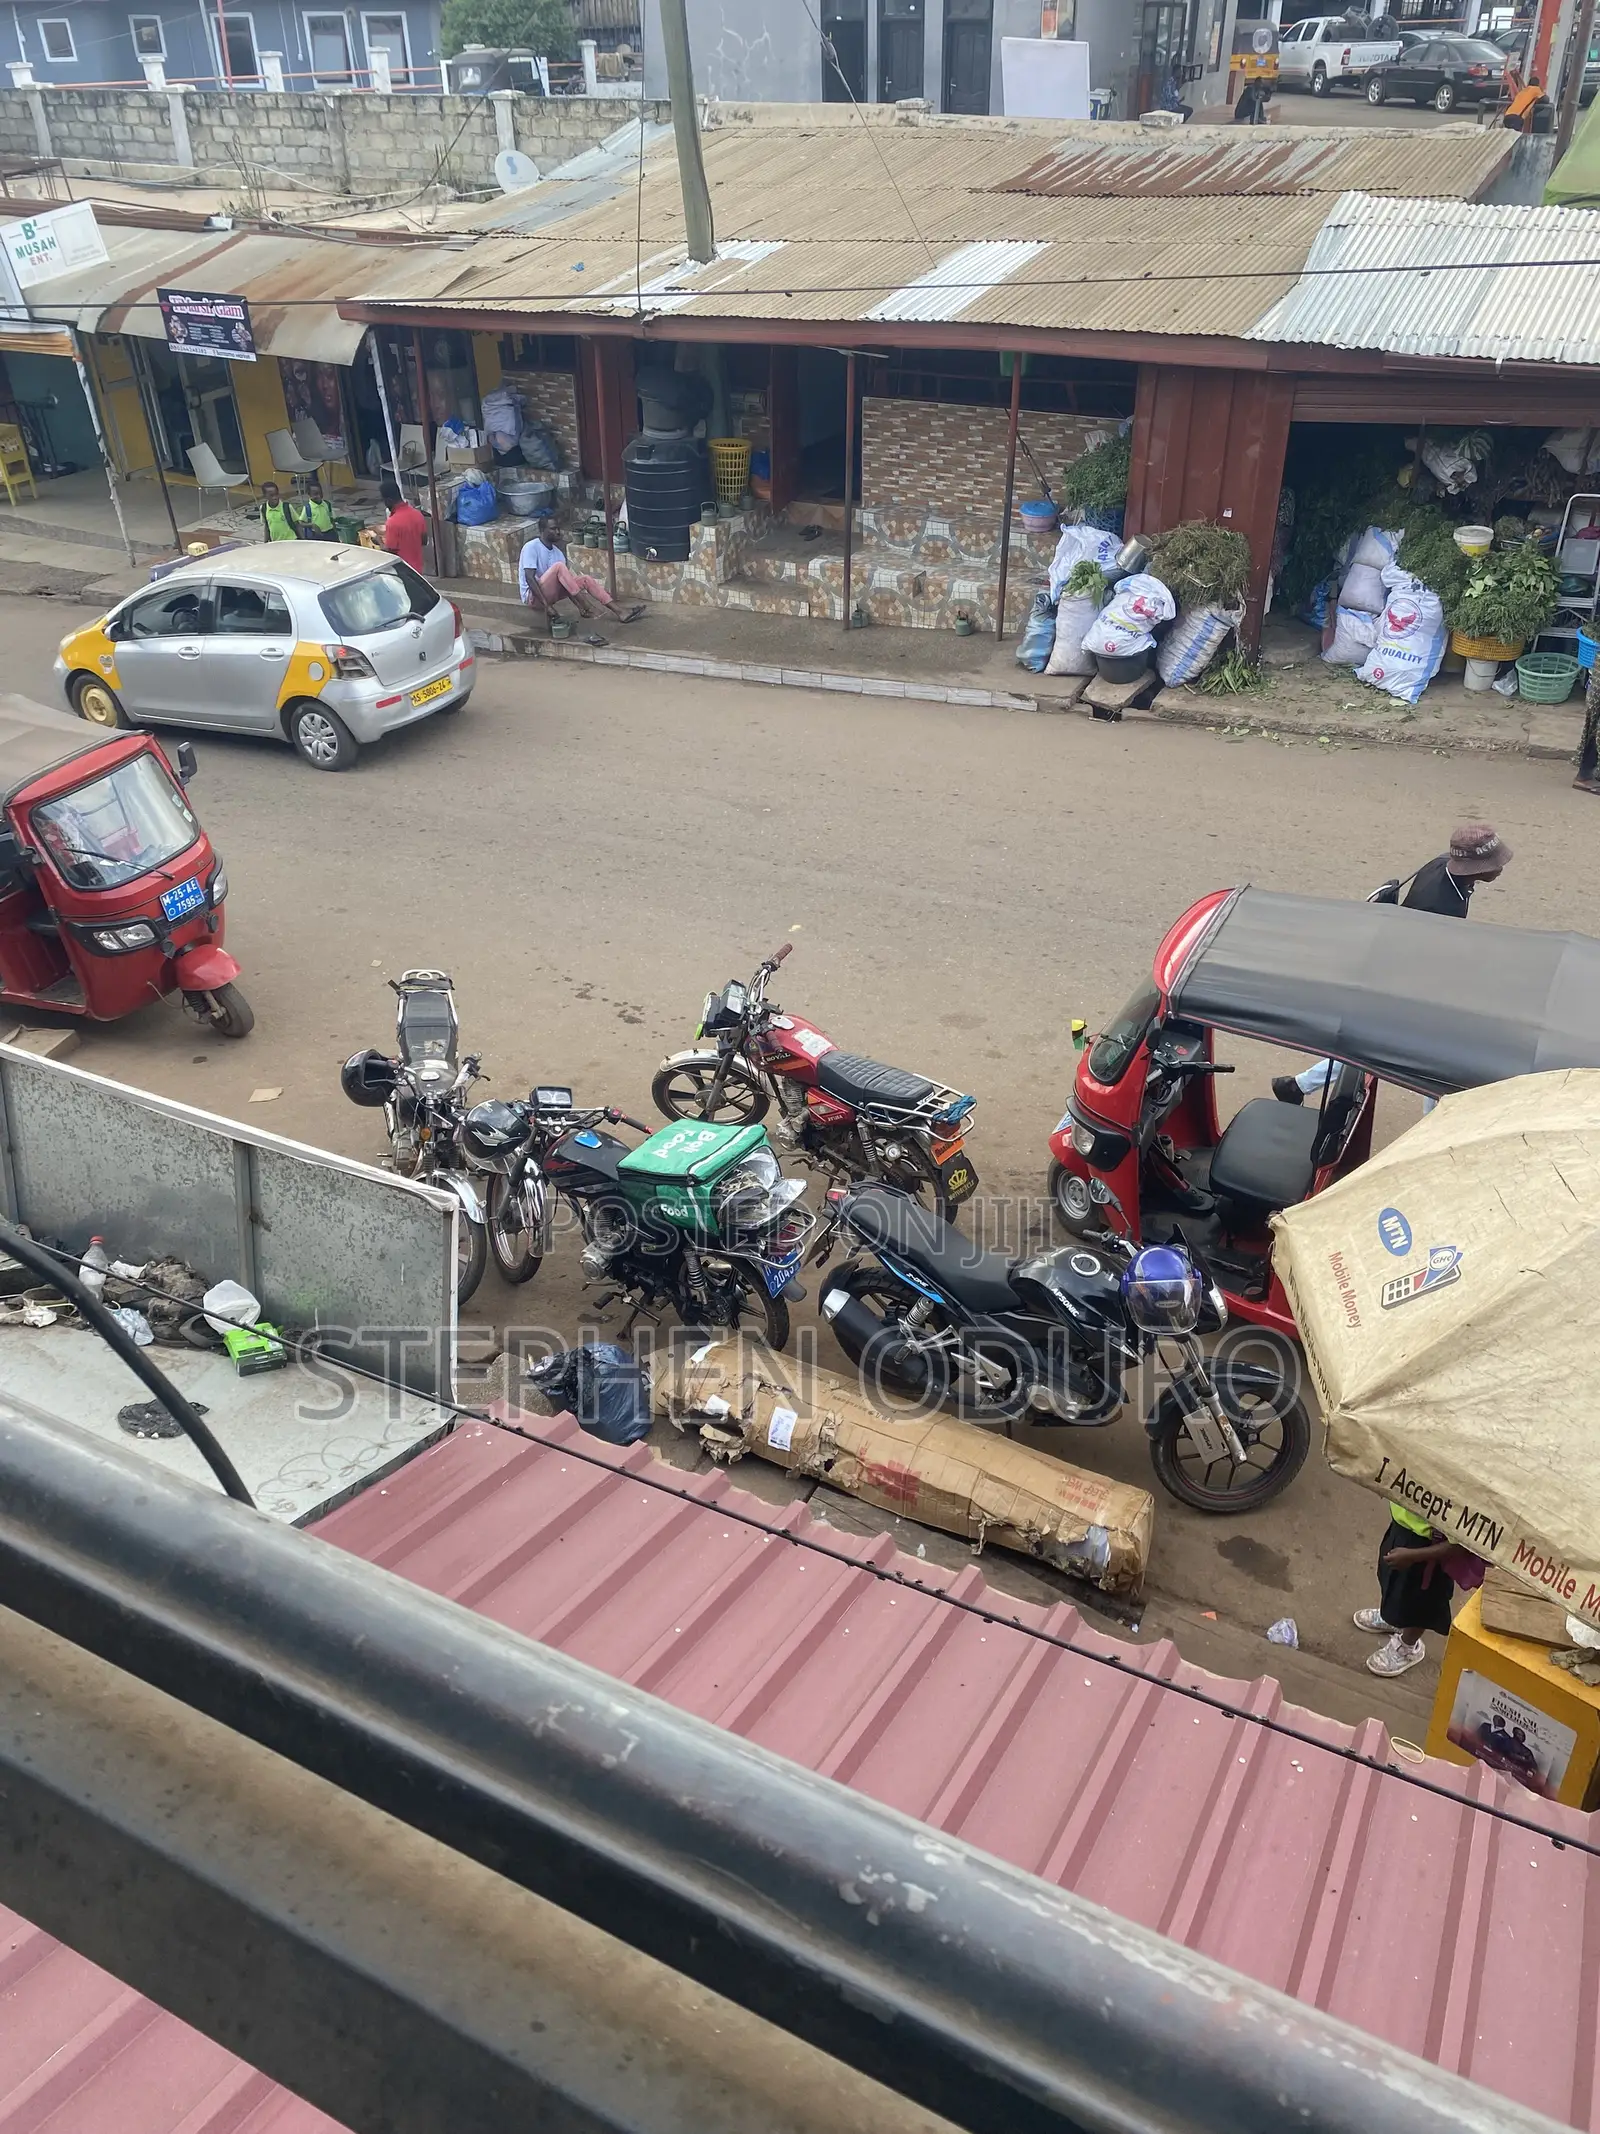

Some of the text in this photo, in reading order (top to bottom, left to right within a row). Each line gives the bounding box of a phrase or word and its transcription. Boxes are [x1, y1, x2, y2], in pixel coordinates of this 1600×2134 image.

[15, 236, 57, 259] MUSAH
[29, 253, 52, 266] ENT.
[1382, 647, 1422, 664] QUALITY
[176, 895, 196, 911] 7595
[651, 1129, 697, 1159] Food
[660, 1203, 689, 1218] Food
[1381, 1215, 1409, 1250] MTN
[1051, 1287, 1081, 1318] APSONIC
[1328, 1251, 1362, 1330] Mobile Money
[1374, 1456, 1600, 1622] I Accept MTN Mobile M
